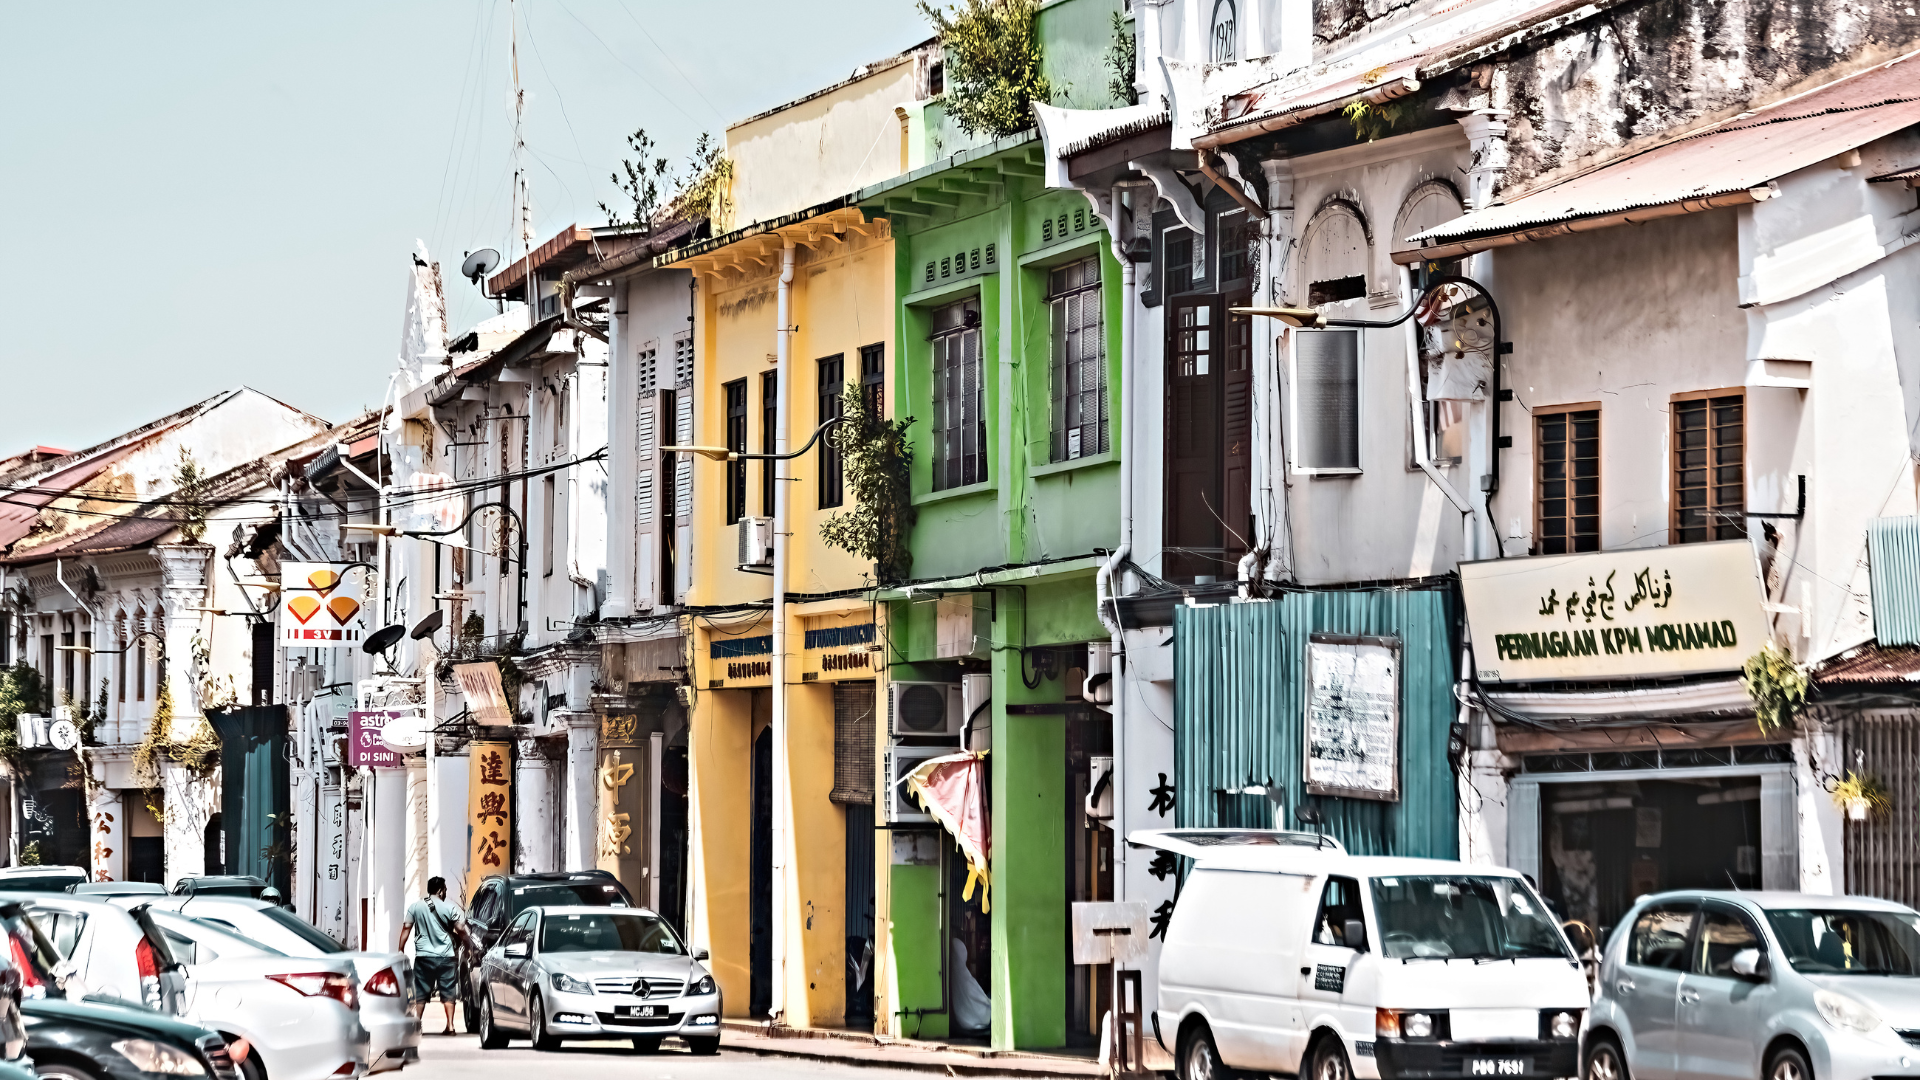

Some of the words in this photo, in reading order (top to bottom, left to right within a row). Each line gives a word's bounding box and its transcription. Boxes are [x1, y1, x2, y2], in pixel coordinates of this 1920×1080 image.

[313, 629, 332, 640] 3V
[1495, 630, 1599, 661] PERNIAGAAN
[1600, 626, 1643, 655] KPM
[1644, 619, 1737, 653] MOHAMAD
[360, 752, 371, 762] DI
[373, 752, 394, 762] SINI
